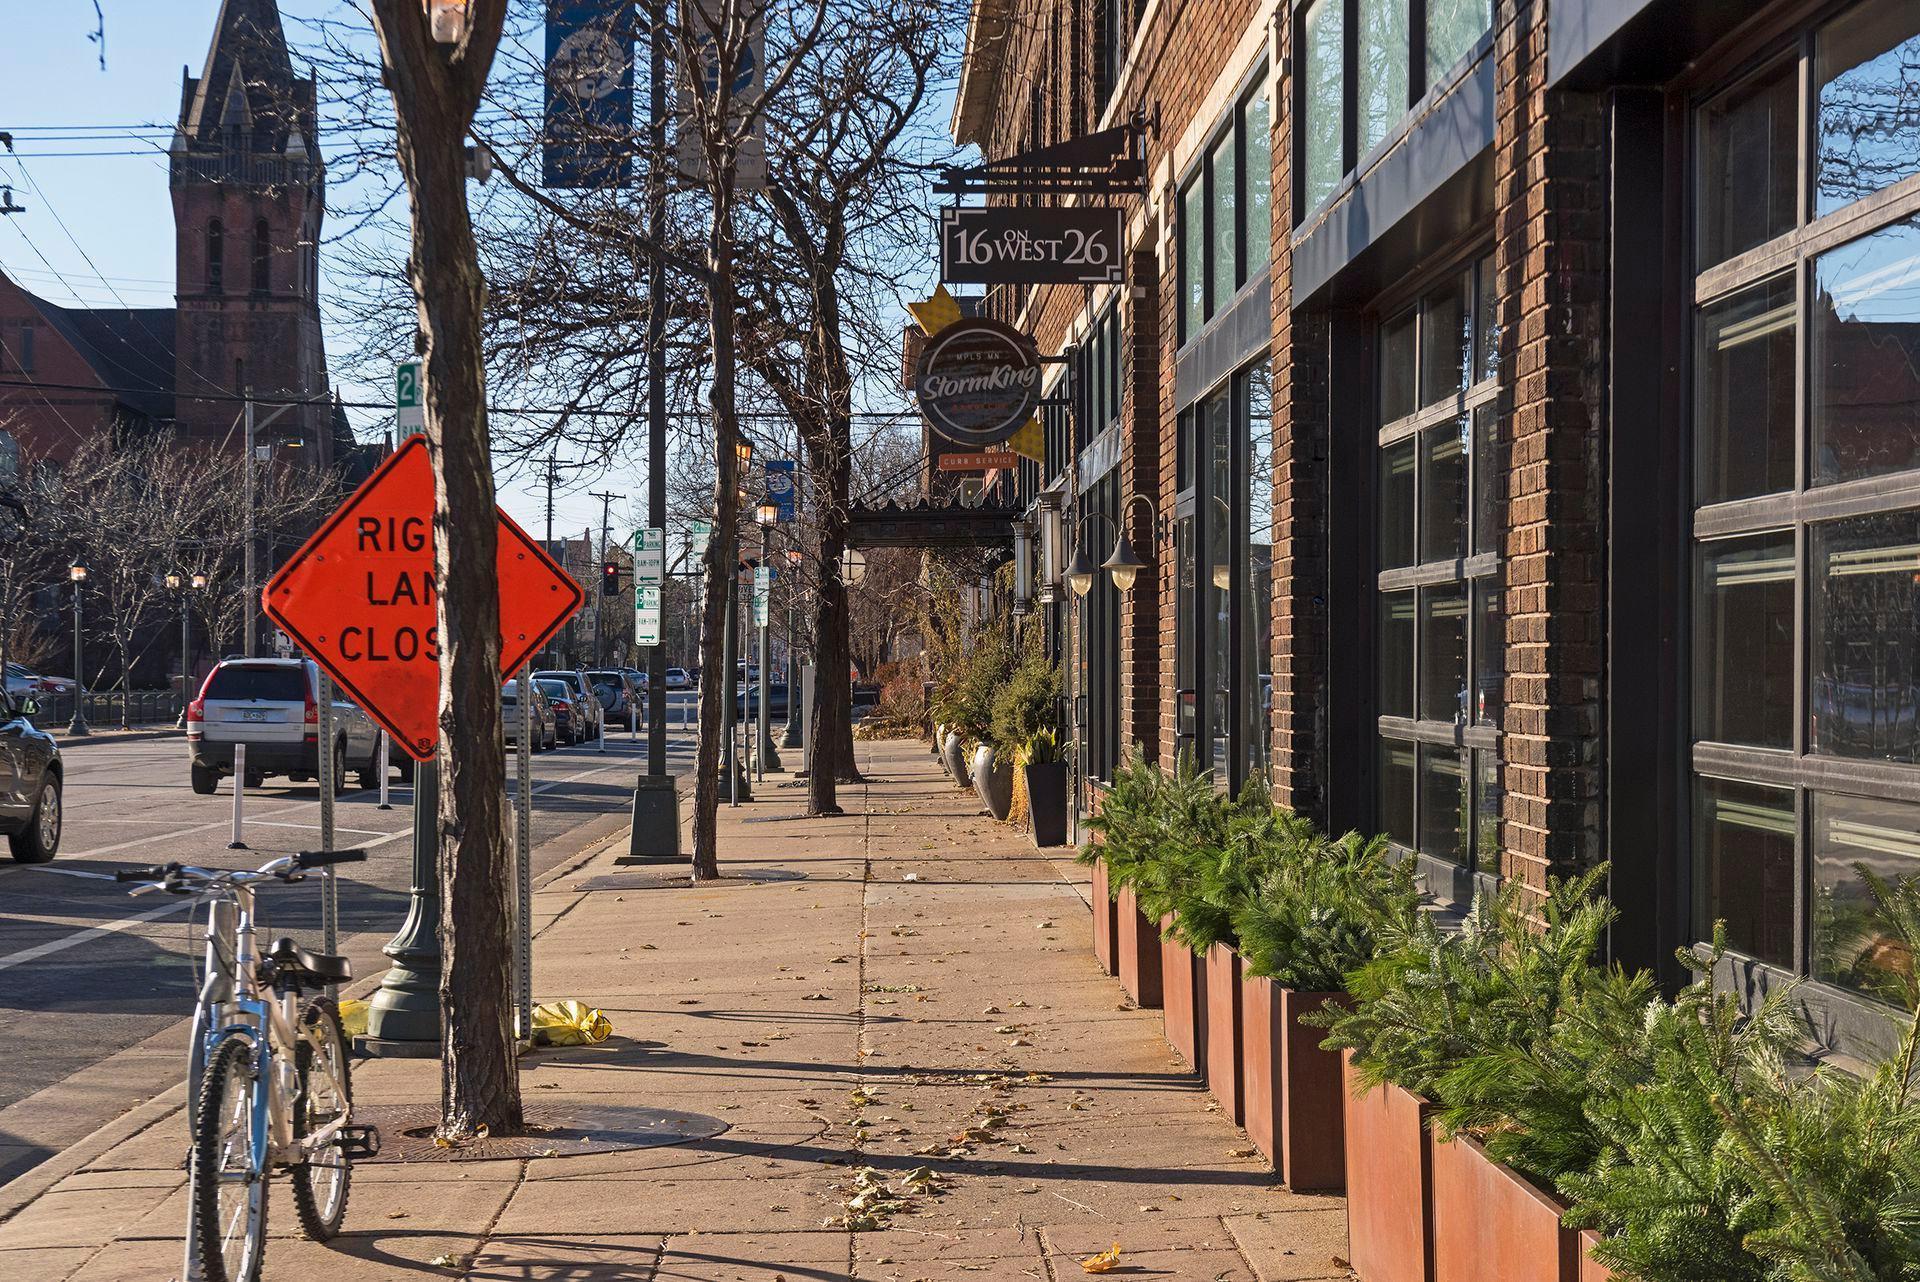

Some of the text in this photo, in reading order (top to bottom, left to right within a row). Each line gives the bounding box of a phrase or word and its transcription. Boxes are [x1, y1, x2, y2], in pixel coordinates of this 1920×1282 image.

[953, 228, 1108, 265] 16 ON WEST 26
[956, 352, 1000, 361] MPLS MN
[400, 372, 413, 400] 2
[923, 364, 1038, 400] StormKing
[944, 457, 1012, 465] CURB SERVICE
[358, 517, 436, 552] RIG
[637, 533, 643, 548] 2
[367, 571, 438, 606] LAN
[339, 626, 441, 661] CLOS
